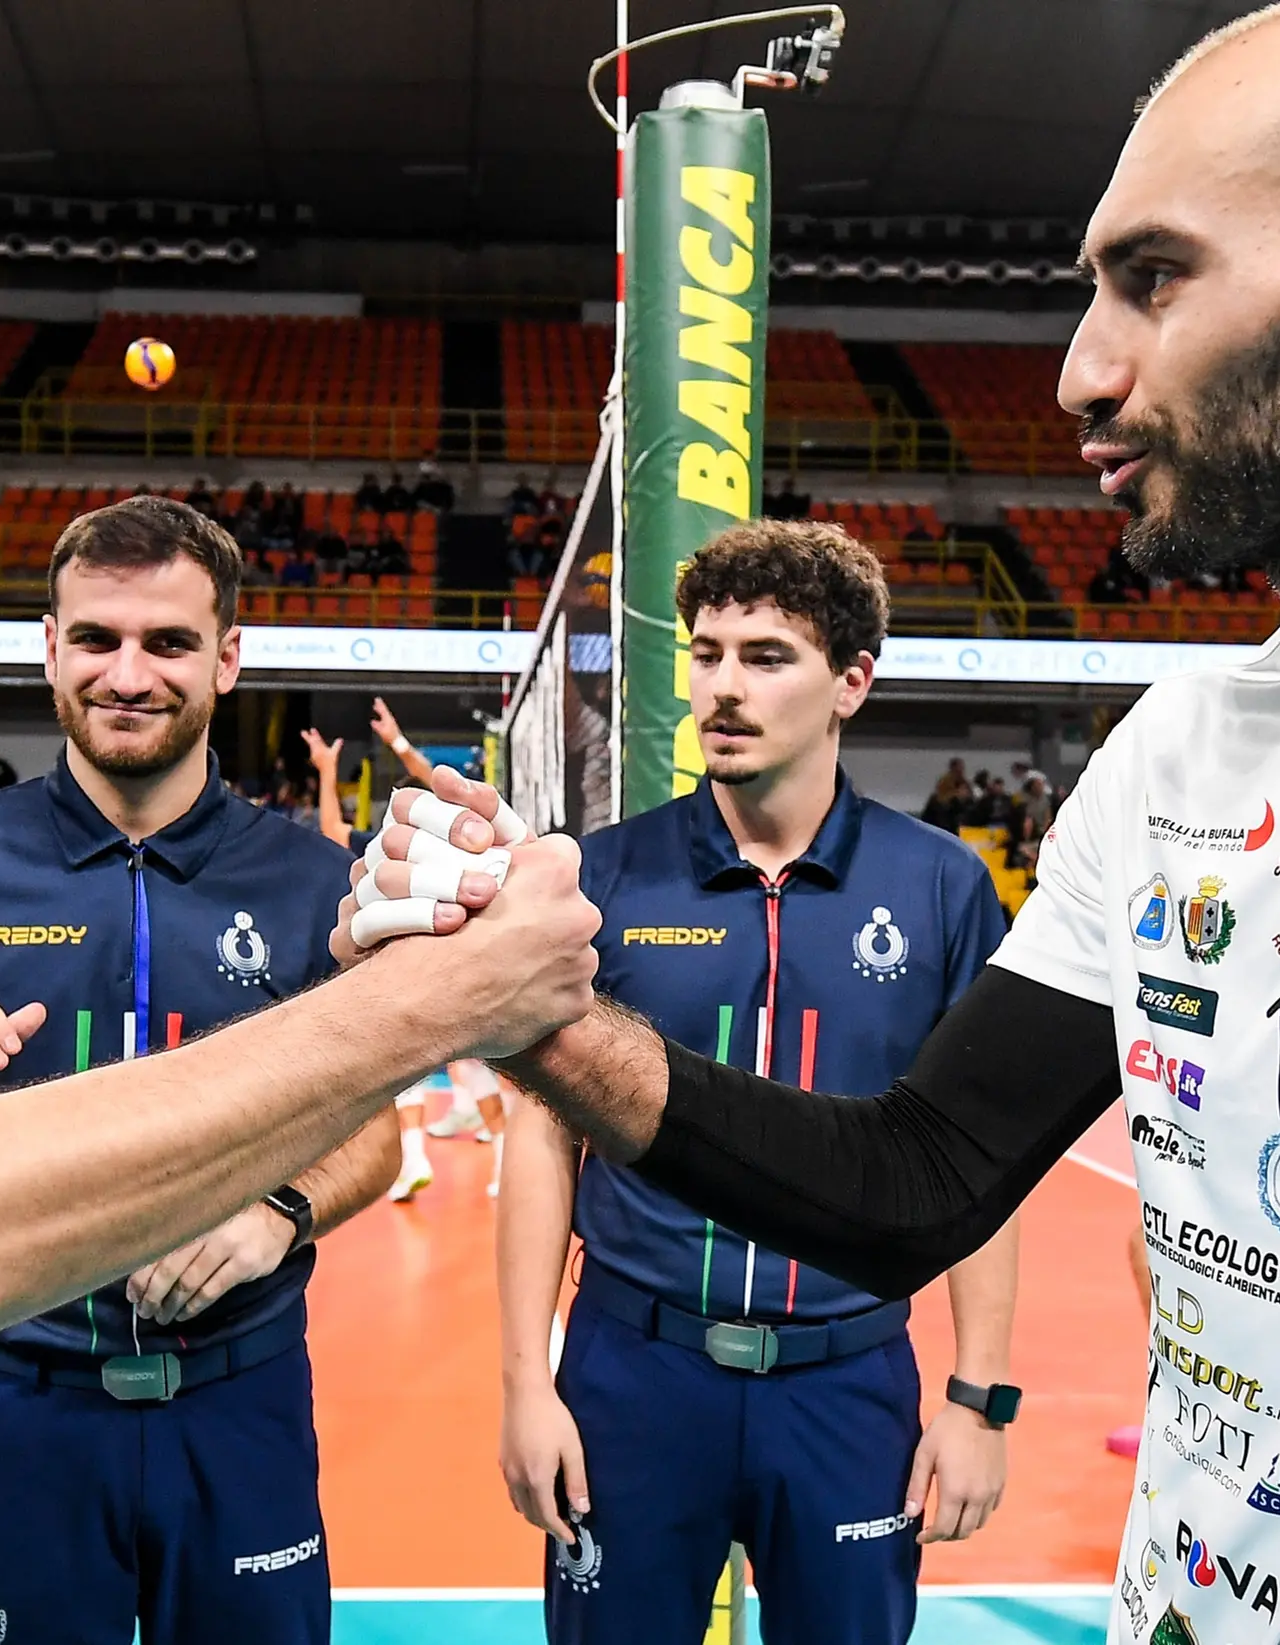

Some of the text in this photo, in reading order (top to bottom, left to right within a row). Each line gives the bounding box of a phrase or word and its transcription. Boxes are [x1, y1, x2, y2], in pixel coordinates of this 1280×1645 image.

[677, 166, 757, 521] BANCA
[1208, 828, 1245, 840] BUFALA
[1208, 841, 1243, 852] mondo
[623, 927, 727, 947] FREDDY
[1143, 1201, 1174, 1245] CTL
[1168, 1248, 1215, 1279] ECOLOGICI
[1215, 1270, 1225, 1283] E
[1153, 1324, 1264, 1414] ansport
[1175, 1384, 1256, 1473] FOTI
[835, 1512, 914, 1543] FREDD
[234, 1534, 320, 1575] FREDDY
